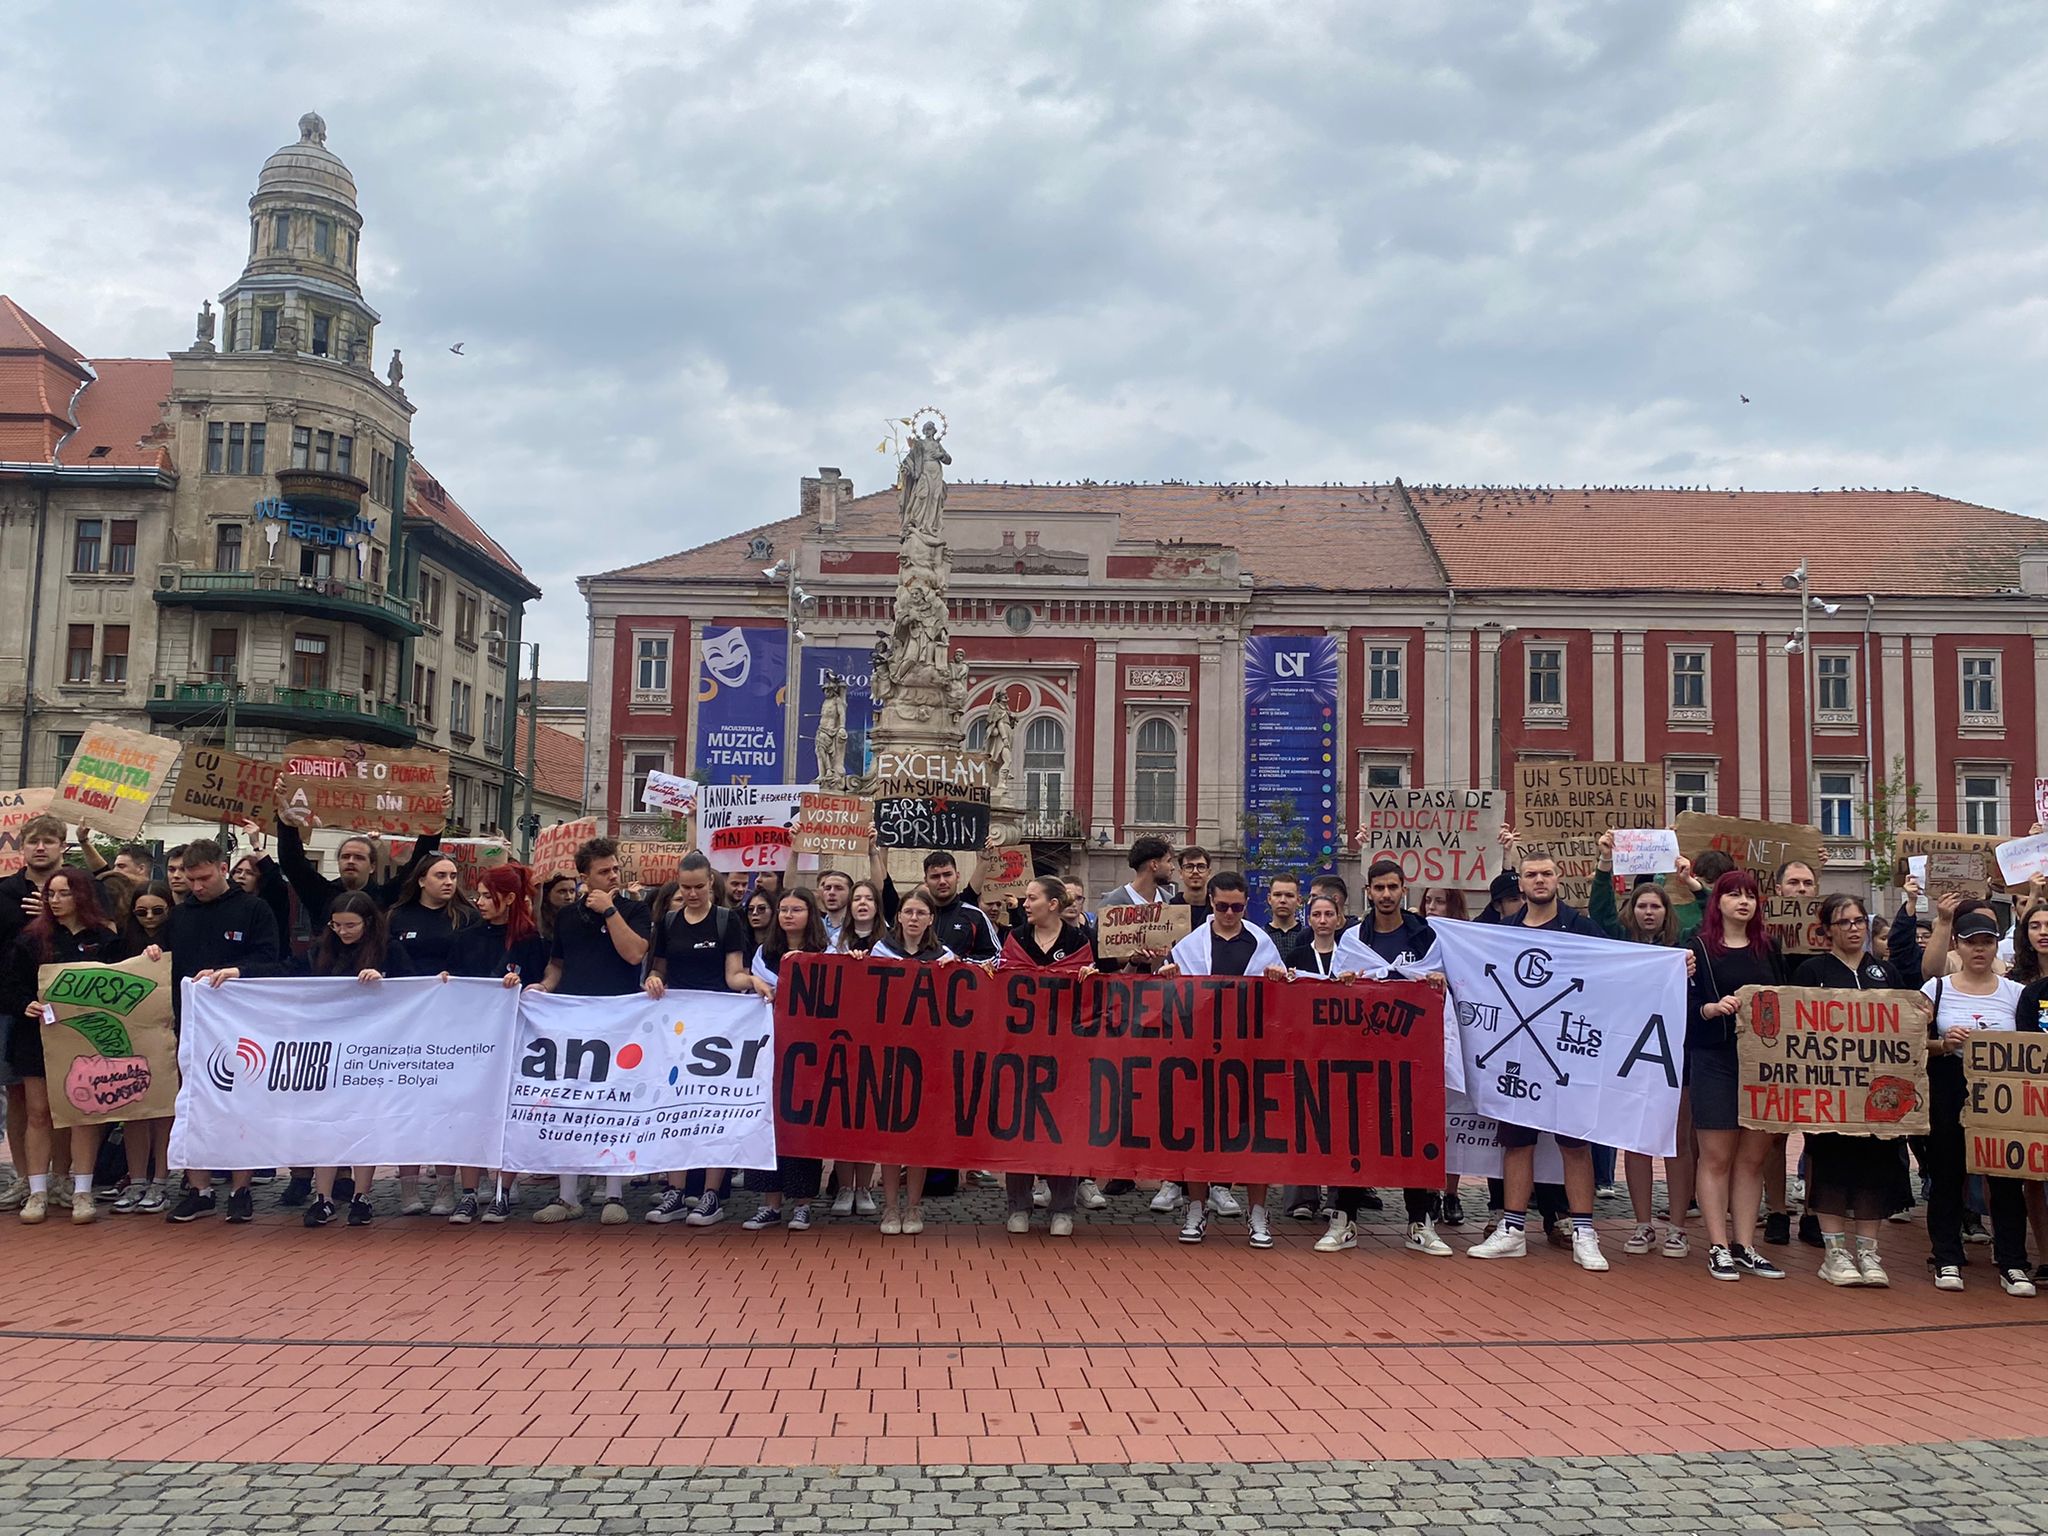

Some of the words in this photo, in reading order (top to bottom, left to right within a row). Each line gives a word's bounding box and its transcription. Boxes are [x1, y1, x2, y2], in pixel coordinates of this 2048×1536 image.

[708, 731, 776, 749] MUZICĂ
[195, 751, 220, 770] CU
[711, 750, 776, 766] TEATRU
[374, 763, 387, 780] O
[878, 753, 988, 786] EXCELĂM
[1523, 769, 1550, 788] UN
[1559, 767, 1650, 787] STUDENT
[290, 788, 308, 806] A
[803, 794, 865, 813] BUGETUL
[1369, 790, 1398, 809] VĂ
[1407, 790, 1455, 808] PASĂ
[1465, 791, 1492, 809] DE
[1620, 792, 1629, 807] E
[1634, 793, 1656, 809] UN
[807, 809, 859, 824] VOSTRU
[1524, 811, 1597, 828] STUDENT
[1605, 811, 1627, 829] CU
[1633, 811, 1656, 829] UN
[880, 814, 976, 847] SPRIJIN
[1370, 830, 1423, 849] PÂNĂ
[1438, 830, 1461, 849] VĂ
[803, 836, 857, 851] NOSTRU
[1746, 838, 1791, 865] NET
[51, 972, 145, 1010] BURSA
[788, 961, 844, 1019] NU
[1005, 974, 1264, 1055] STUDENȚII
[1795, 999, 1900, 1034] NICIUN
[346, 1044, 421, 1056] Organizația
[426, 1042, 495, 1056] Studenților
[1616, 1013, 1679, 1089] A
[343, 1059, 364, 1070] din
[369, 1059, 454, 1070] Universitatea
[342, 1074, 384, 1087] Babeș
[397, 1074, 438, 1087] Bolyai
[1759, 1062, 1799, 1084] DAR
[1805, 1065, 1870, 1087] MULTE
[514, 1084, 631, 1103] REPREZENTĂM
[675, 1084, 760, 1097] VIITORUL!
[781, 1029, 922, 1133] CÂND
[952, 1049, 1063, 1144] VOR
[1088, 1056, 1439, 1173] DECIDENȚII.
[1994, 1083, 2013, 1114] O
[1743, 1084, 1847, 1123] TĂIERI
[511, 1109, 556, 1124] Alianța
[562, 1111, 639, 1128] Națională
[656, 1107, 762, 1124] Organizațiilor
[538, 1128, 631, 1146] Studențești
[637, 1130, 656, 1144] din
[661, 1123, 725, 1140] România
[1974, 1136, 2006, 1169] NU
[2005, 1140, 2025, 1170] O
